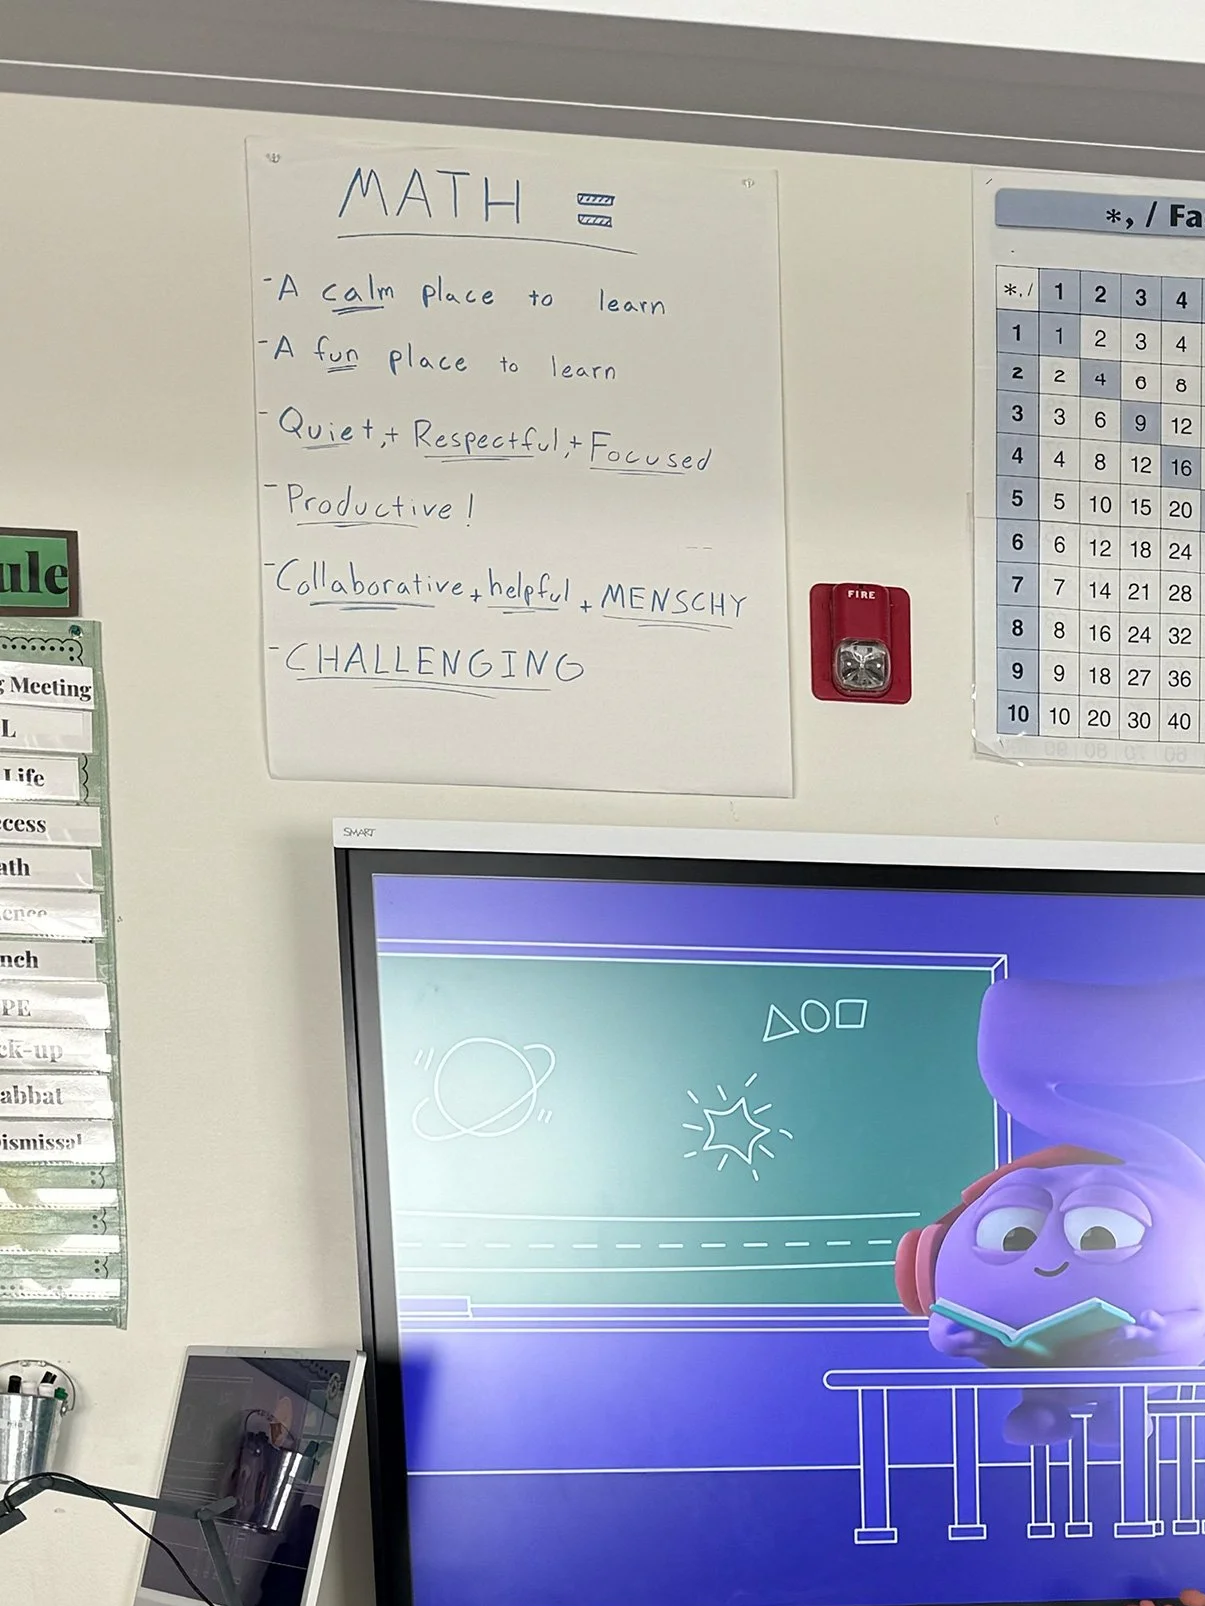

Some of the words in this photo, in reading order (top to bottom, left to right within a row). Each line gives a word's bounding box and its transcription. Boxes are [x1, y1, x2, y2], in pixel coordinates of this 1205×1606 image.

[339, 167, 519, 224] MATH
[322, 273, 394, 302] calm
[423, 275, 493, 308] place
[529, 290, 552, 306] to
[600, 289, 665, 314] learn
[1055, 283, 1062, 299] 1
[1095, 286, 1106, 302] 2
[1136, 289, 1146, 306] 3
[1176, 292, 1187, 309] 4
[314, 336, 358, 362] fun
[390, 343, 467, 375] place
[500, 356, 518, 372] to
[552, 355, 615, 379] learn
[589, 431, 712, 465] Focused
[488, 568, 569, 606] helpful
[601, 583, 747, 618] MENSCHY
[848, 590, 875, 600] FIRE
[10, 676, 92, 702] Meeting
[343, 827, 376, 837] SMART
[2, 1000, 31, 1017] PE
[0, 1134, 82, 1151] ismissal
